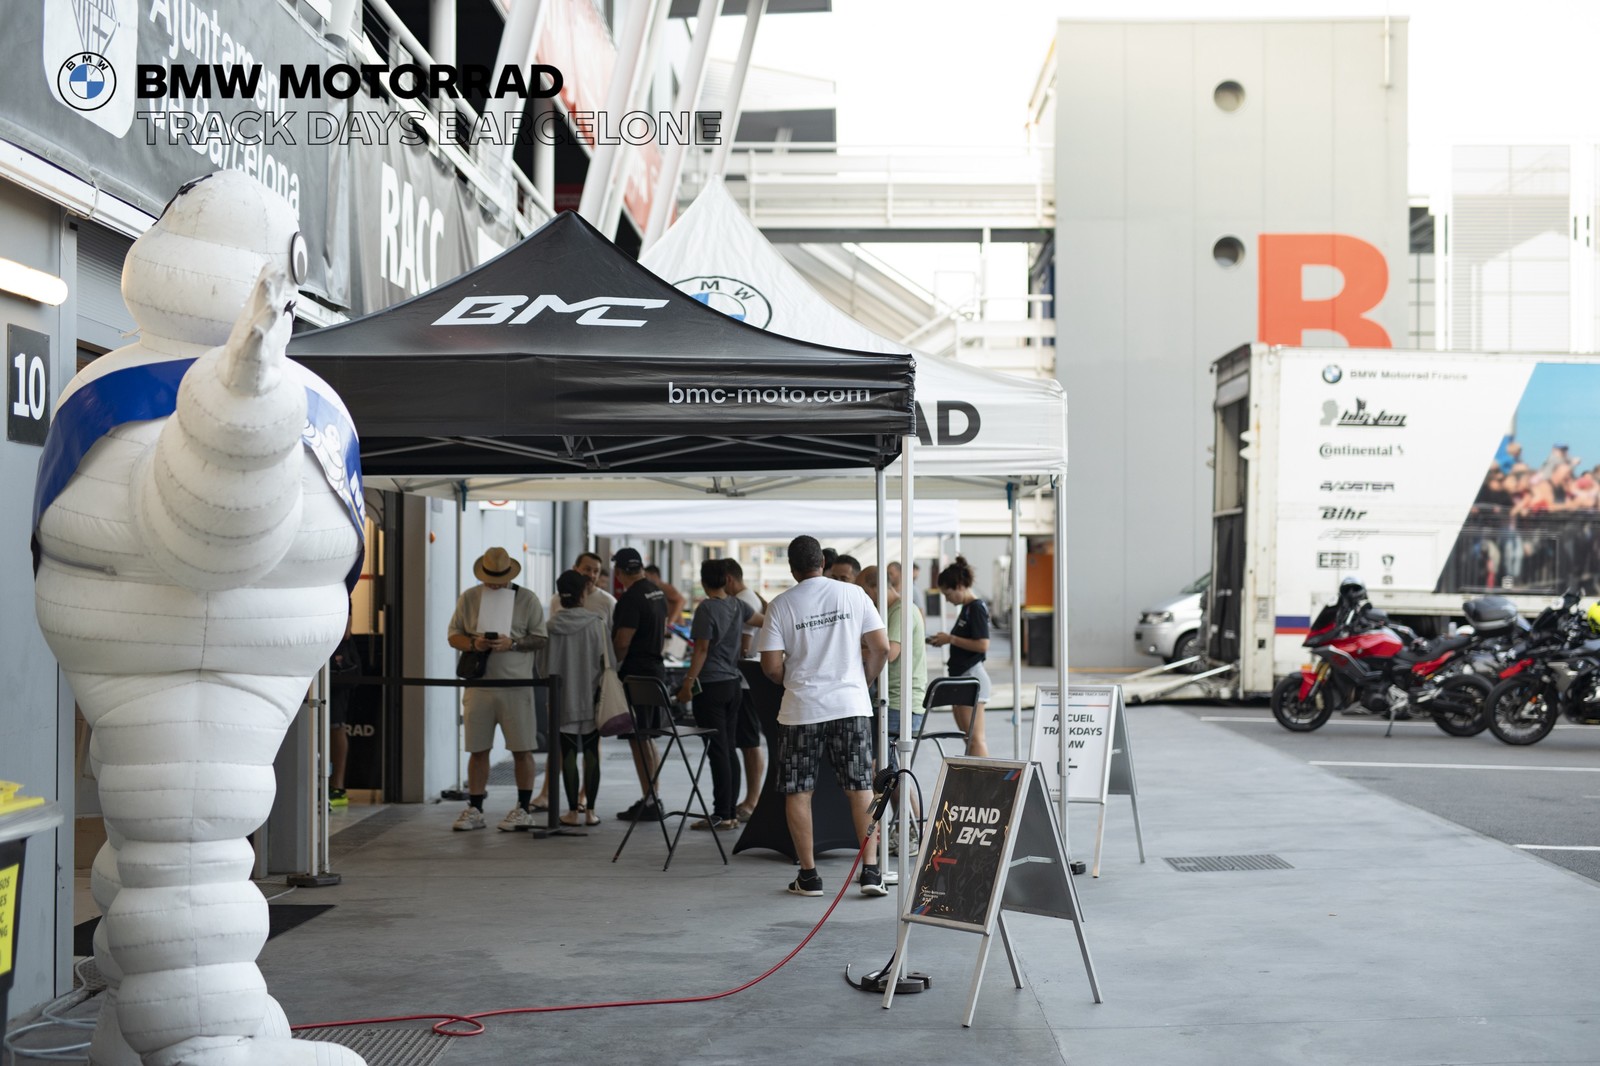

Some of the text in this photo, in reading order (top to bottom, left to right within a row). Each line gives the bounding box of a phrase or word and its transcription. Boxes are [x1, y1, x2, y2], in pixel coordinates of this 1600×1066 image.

[380, 161, 445, 297] RACC
[700, 280, 756, 301] MW
[431, 294, 670, 328] BMC
[13, 352, 46, 421] 10
[668, 381, 871, 404] bmc-moto.com
[1319, 443, 1394, 459] Continental
[1319, 506, 1368, 520] Bihr
[1052, 713, 1095, 723] ACUEIL
[1043, 726, 1103, 736] TRAKDAYS
[949, 805, 1001, 825] STAND
[955, 826, 998, 847] BMC
